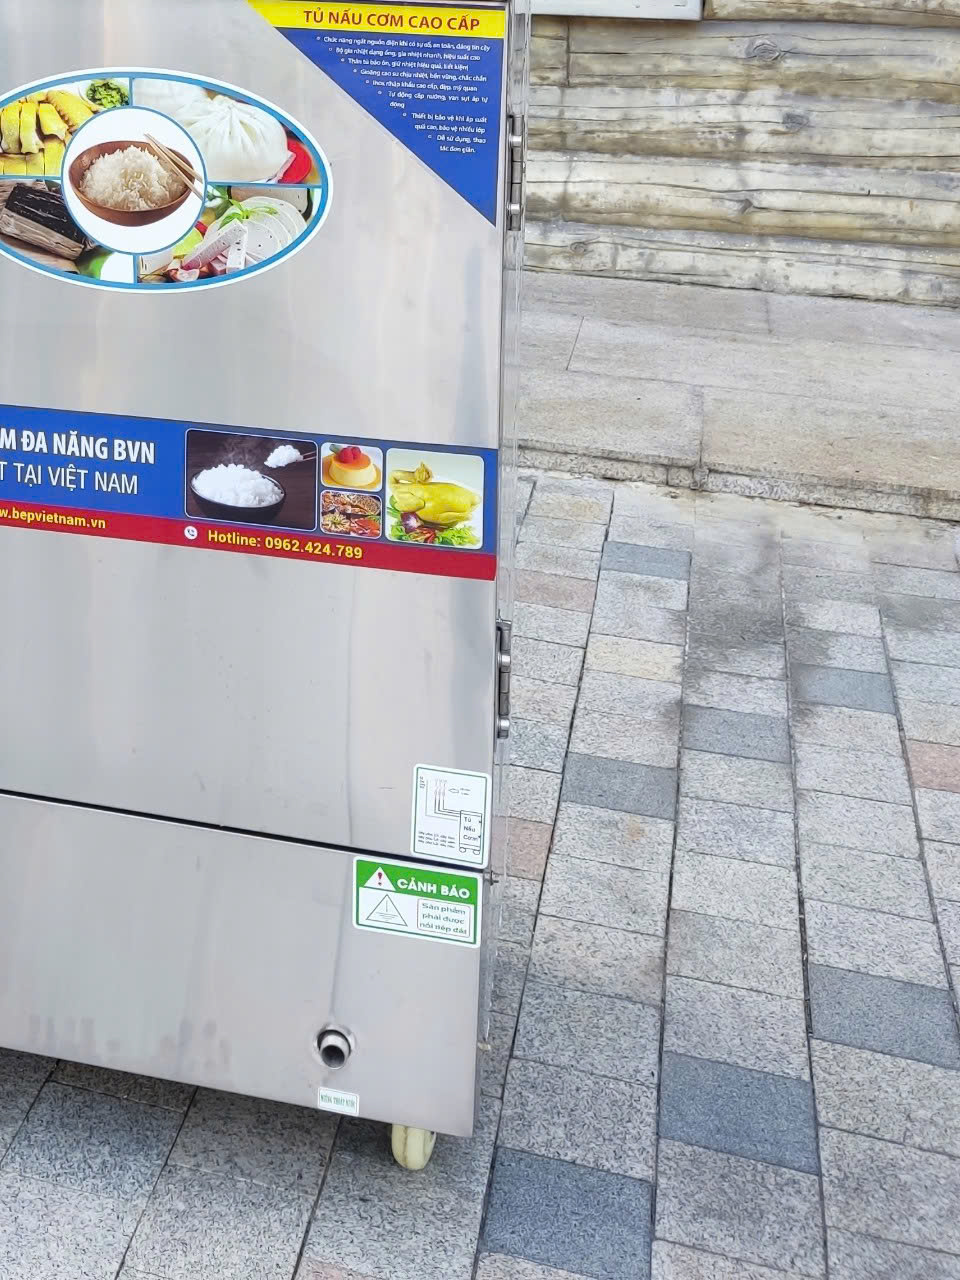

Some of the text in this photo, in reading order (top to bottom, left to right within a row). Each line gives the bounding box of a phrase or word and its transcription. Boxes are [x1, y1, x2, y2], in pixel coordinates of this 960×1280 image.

[304, 8, 480, 31] TỦ NẤU CƠM CAO CẤP
[21, 429, 48, 453] ĐA
[53, 430, 108, 460] NĂNG
[113, 440, 155, 465] BVN
[13, 462, 41, 489] TẠI
[47, 464, 88, 492] VIỆT
[95, 471, 138, 495] NAM
[208, 529, 363, 560] Hotline: 0962.424.789
[397, 877, 470, 899] CẢNH BÁO
